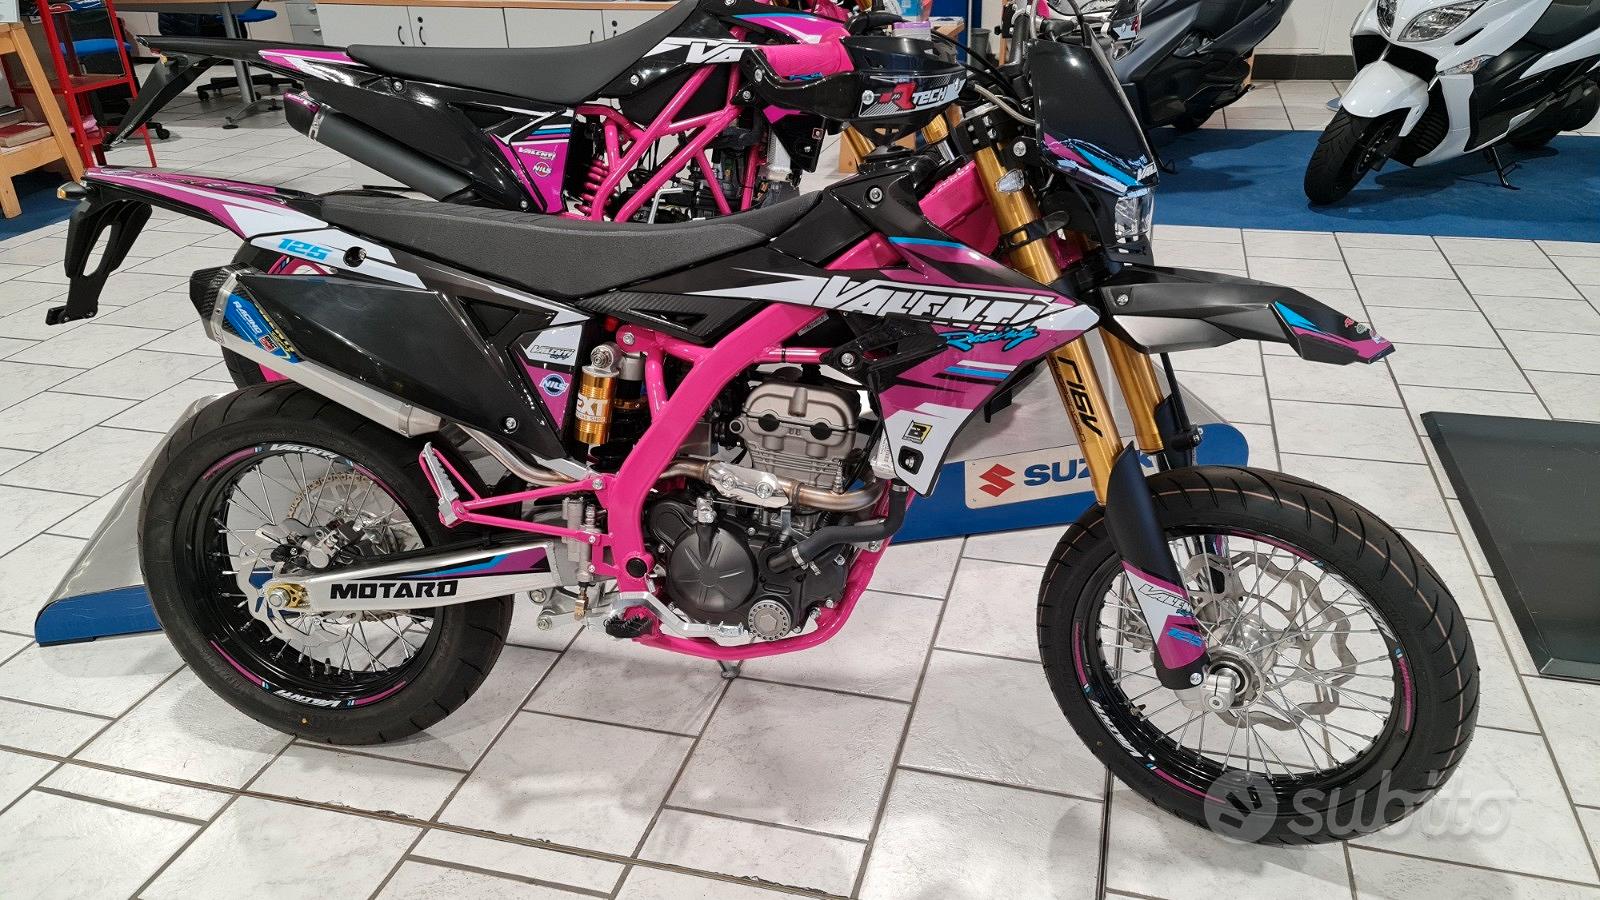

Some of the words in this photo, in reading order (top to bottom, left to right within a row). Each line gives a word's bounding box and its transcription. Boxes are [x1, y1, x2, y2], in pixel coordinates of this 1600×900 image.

[533, 163, 552, 174] NILS
[277, 238, 332, 261] 125
[812, 275, 1061, 327] VALENTI
[233, 300, 263, 335] RACING
[936, 324, 1040, 351] Racing
[540, 379, 569, 391] NILS
[330, 580, 459, 599] MOTARD
